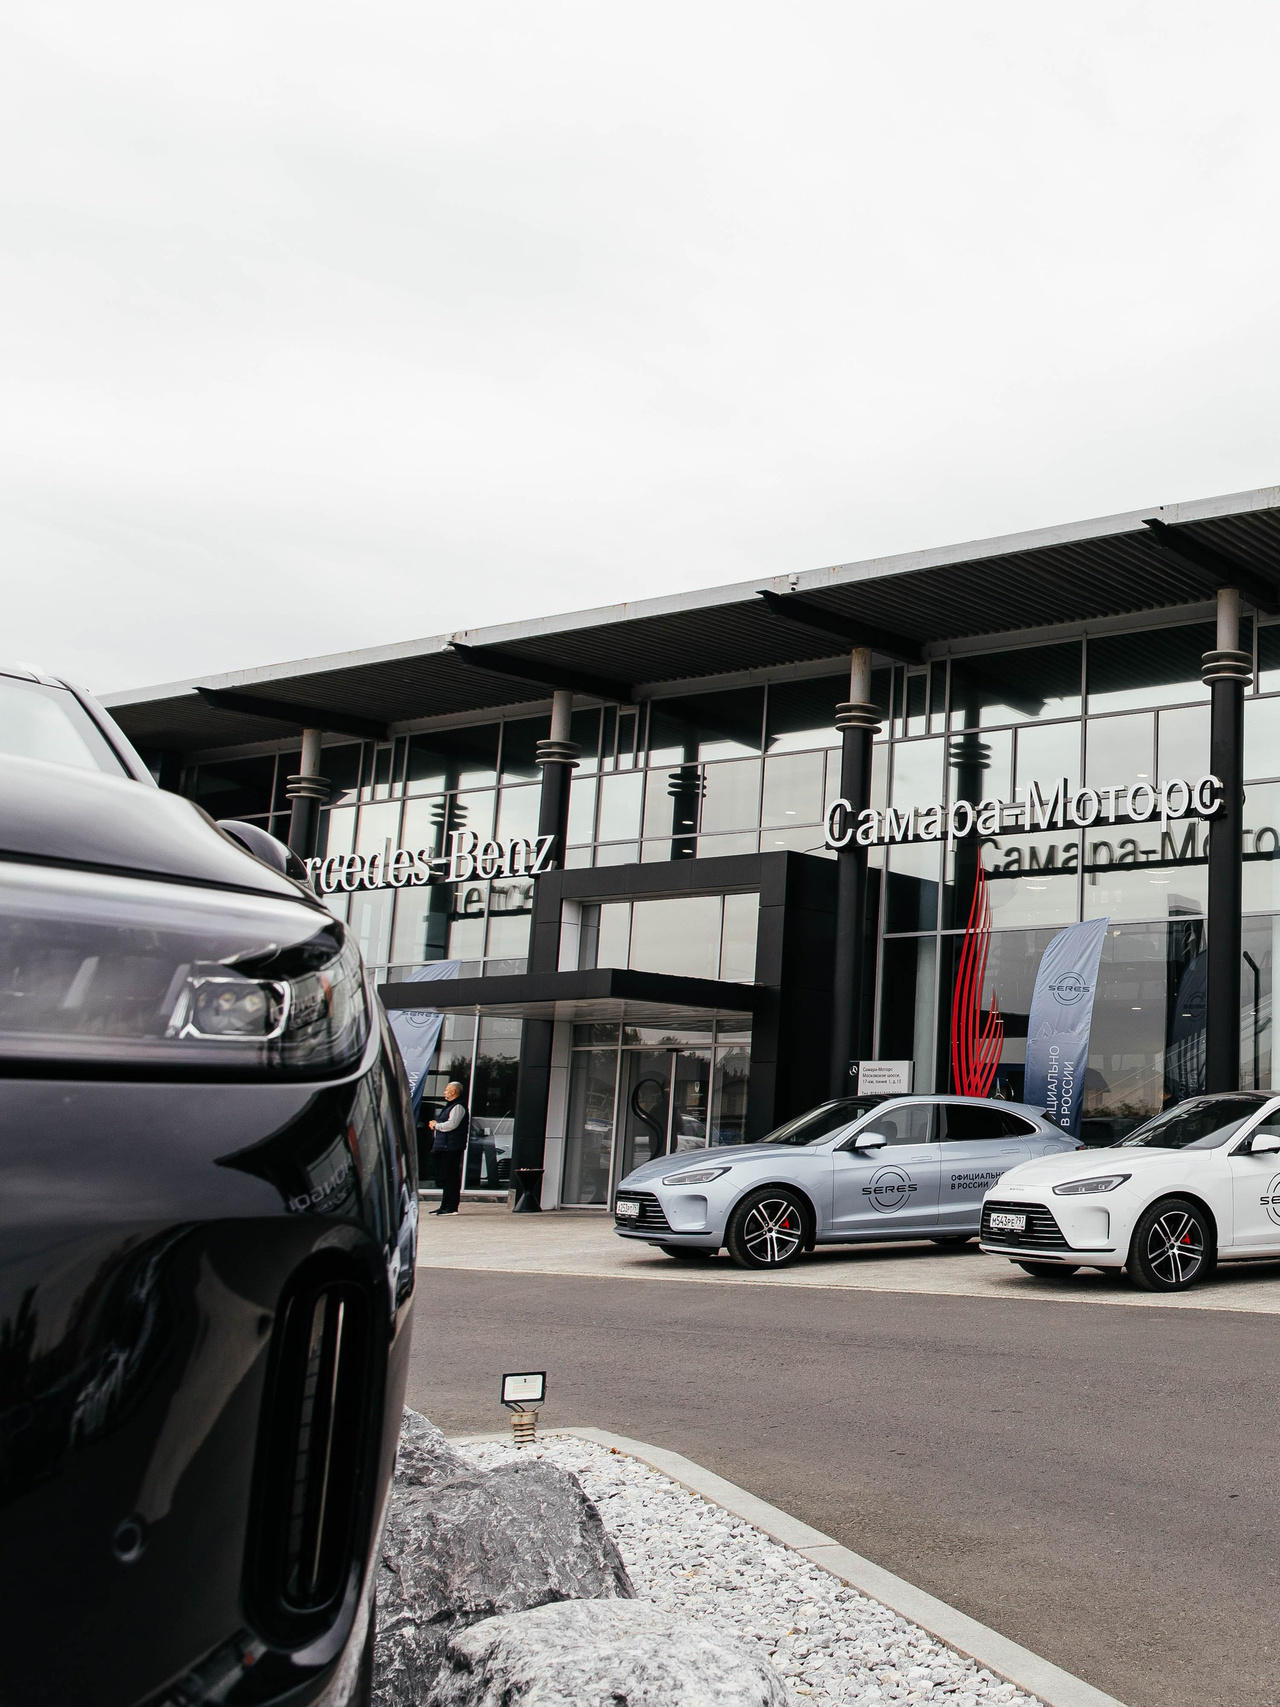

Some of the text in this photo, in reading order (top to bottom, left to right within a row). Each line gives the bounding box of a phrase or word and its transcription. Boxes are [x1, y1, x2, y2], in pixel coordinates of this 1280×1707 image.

[822, 774, 1223, 853] Самара-Моторс
[303, 830, 556, 893] rcedes-Benz
[1048, 984, 1091, 993] SERES
[1060, 1061, 1075, 1126] В РОССИИ
[951, 1171, 1005, 1182] ОФИЦИАЛЬН
[861, 1183, 918, 1195] SERES
[957, 1181, 989, 1190] РОССИИ
